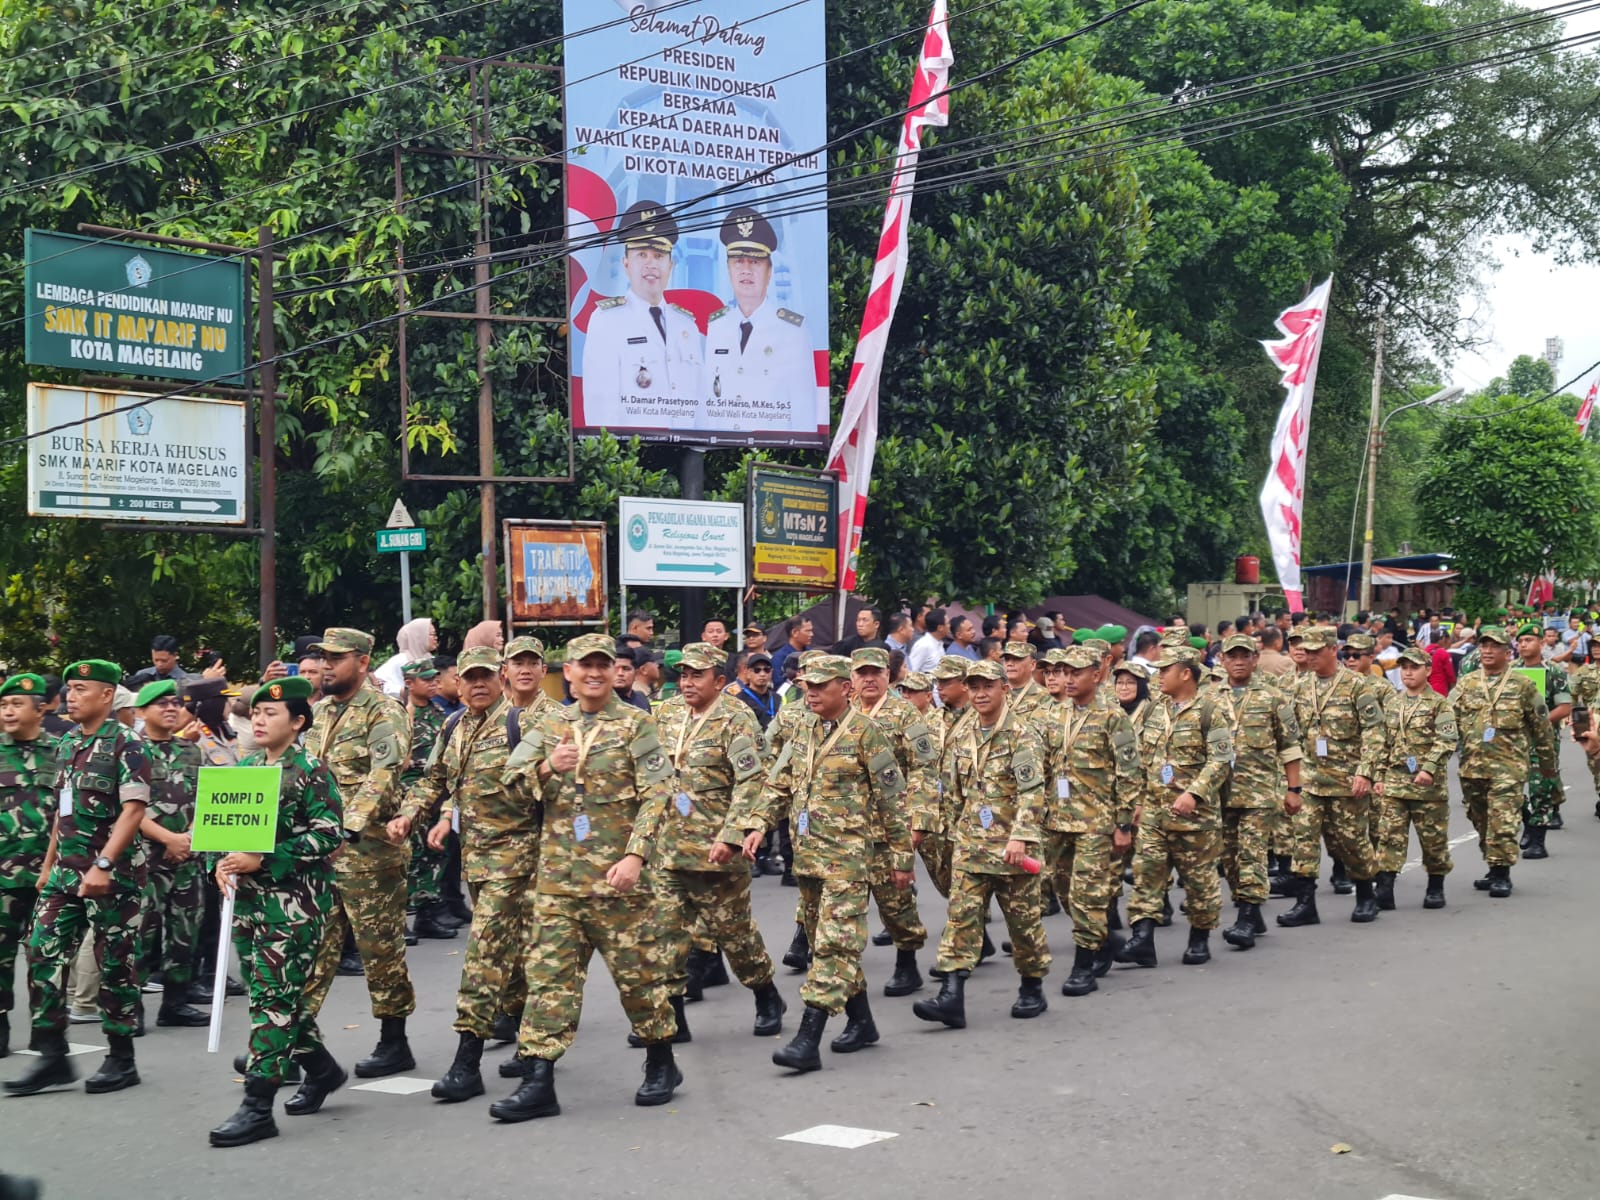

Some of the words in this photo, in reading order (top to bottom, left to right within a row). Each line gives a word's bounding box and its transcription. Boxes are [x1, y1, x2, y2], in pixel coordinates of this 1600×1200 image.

[629, 5, 701, 40] Selamat
[701, 16, 766, 56] Datang
[663, 48, 735, 72] PRESIDEN
[619, 65, 691, 88] REPUBLIK
[695, 76, 777, 100] INDONESIA
[663, 92, 737, 117] BERSAMA
[619, 110, 679, 131] KEPALA
[682, 118, 744, 140] DAERAH
[747, 126, 779, 144] DAN
[576, 127, 629, 149] WAKIL
[632, 133, 691, 155] KEPALA
[694, 141, 755, 163] DAERAH
[758, 149, 818, 170] TERPILIH
[625, 156, 640, 172] DI
[645, 158, 687, 177] KOTA
[692, 164, 776, 186] MAGELANG
[37, 282, 95, 306] LEMBAGA
[97, 291, 168, 316] PENDIDIKAN
[170, 301, 214, 321] MA'ARIF
[217, 308, 233, 324] NU
[44, 305, 88, 337] SMK
[94, 311, 112, 339] IT
[117, 314, 197, 351] MA'ARIF
[201, 326, 226, 352] NU
[71, 339, 113, 363] KOTA
[117, 344, 203, 372] MAGELANG
[621, 395, 629, 404] H.
[631, 396, 656, 405] Damar
[658, 396, 699, 407] Prasetyono
[626, 406, 641, 415] Wali
[643, 407, 659, 416] Kota
[660, 407, 695, 419] Magelang
[717, 398, 727, 407] Sri
[707, 409, 725, 418] Wakil
[742, 410, 757, 419] Kota
[758, 411, 792, 422] Magelang
[51, 435, 106, 454] BURSA
[110, 440, 160, 458] KERJA
[165, 444, 226, 461] KHUSUS
[39, 454, 67, 468] SMK
[72, 456, 126, 472] MA'ARIF
[130, 460, 164, 474] KOTA
[168, 462, 238, 478] MAGELANG
[129, 499, 144, 508] 200
[145, 500, 174, 510] METER
[783, 511, 816, 532] MTsN
[818, 515, 827, 533] 2
[662, 528, 699, 542] Religious
[702, 530, 725, 542] Court
[211, 792, 252, 804] KOMPI
[255, 792, 264, 804] D
[203, 813, 260, 826] PELETON
[264, 814, 268, 826] I
